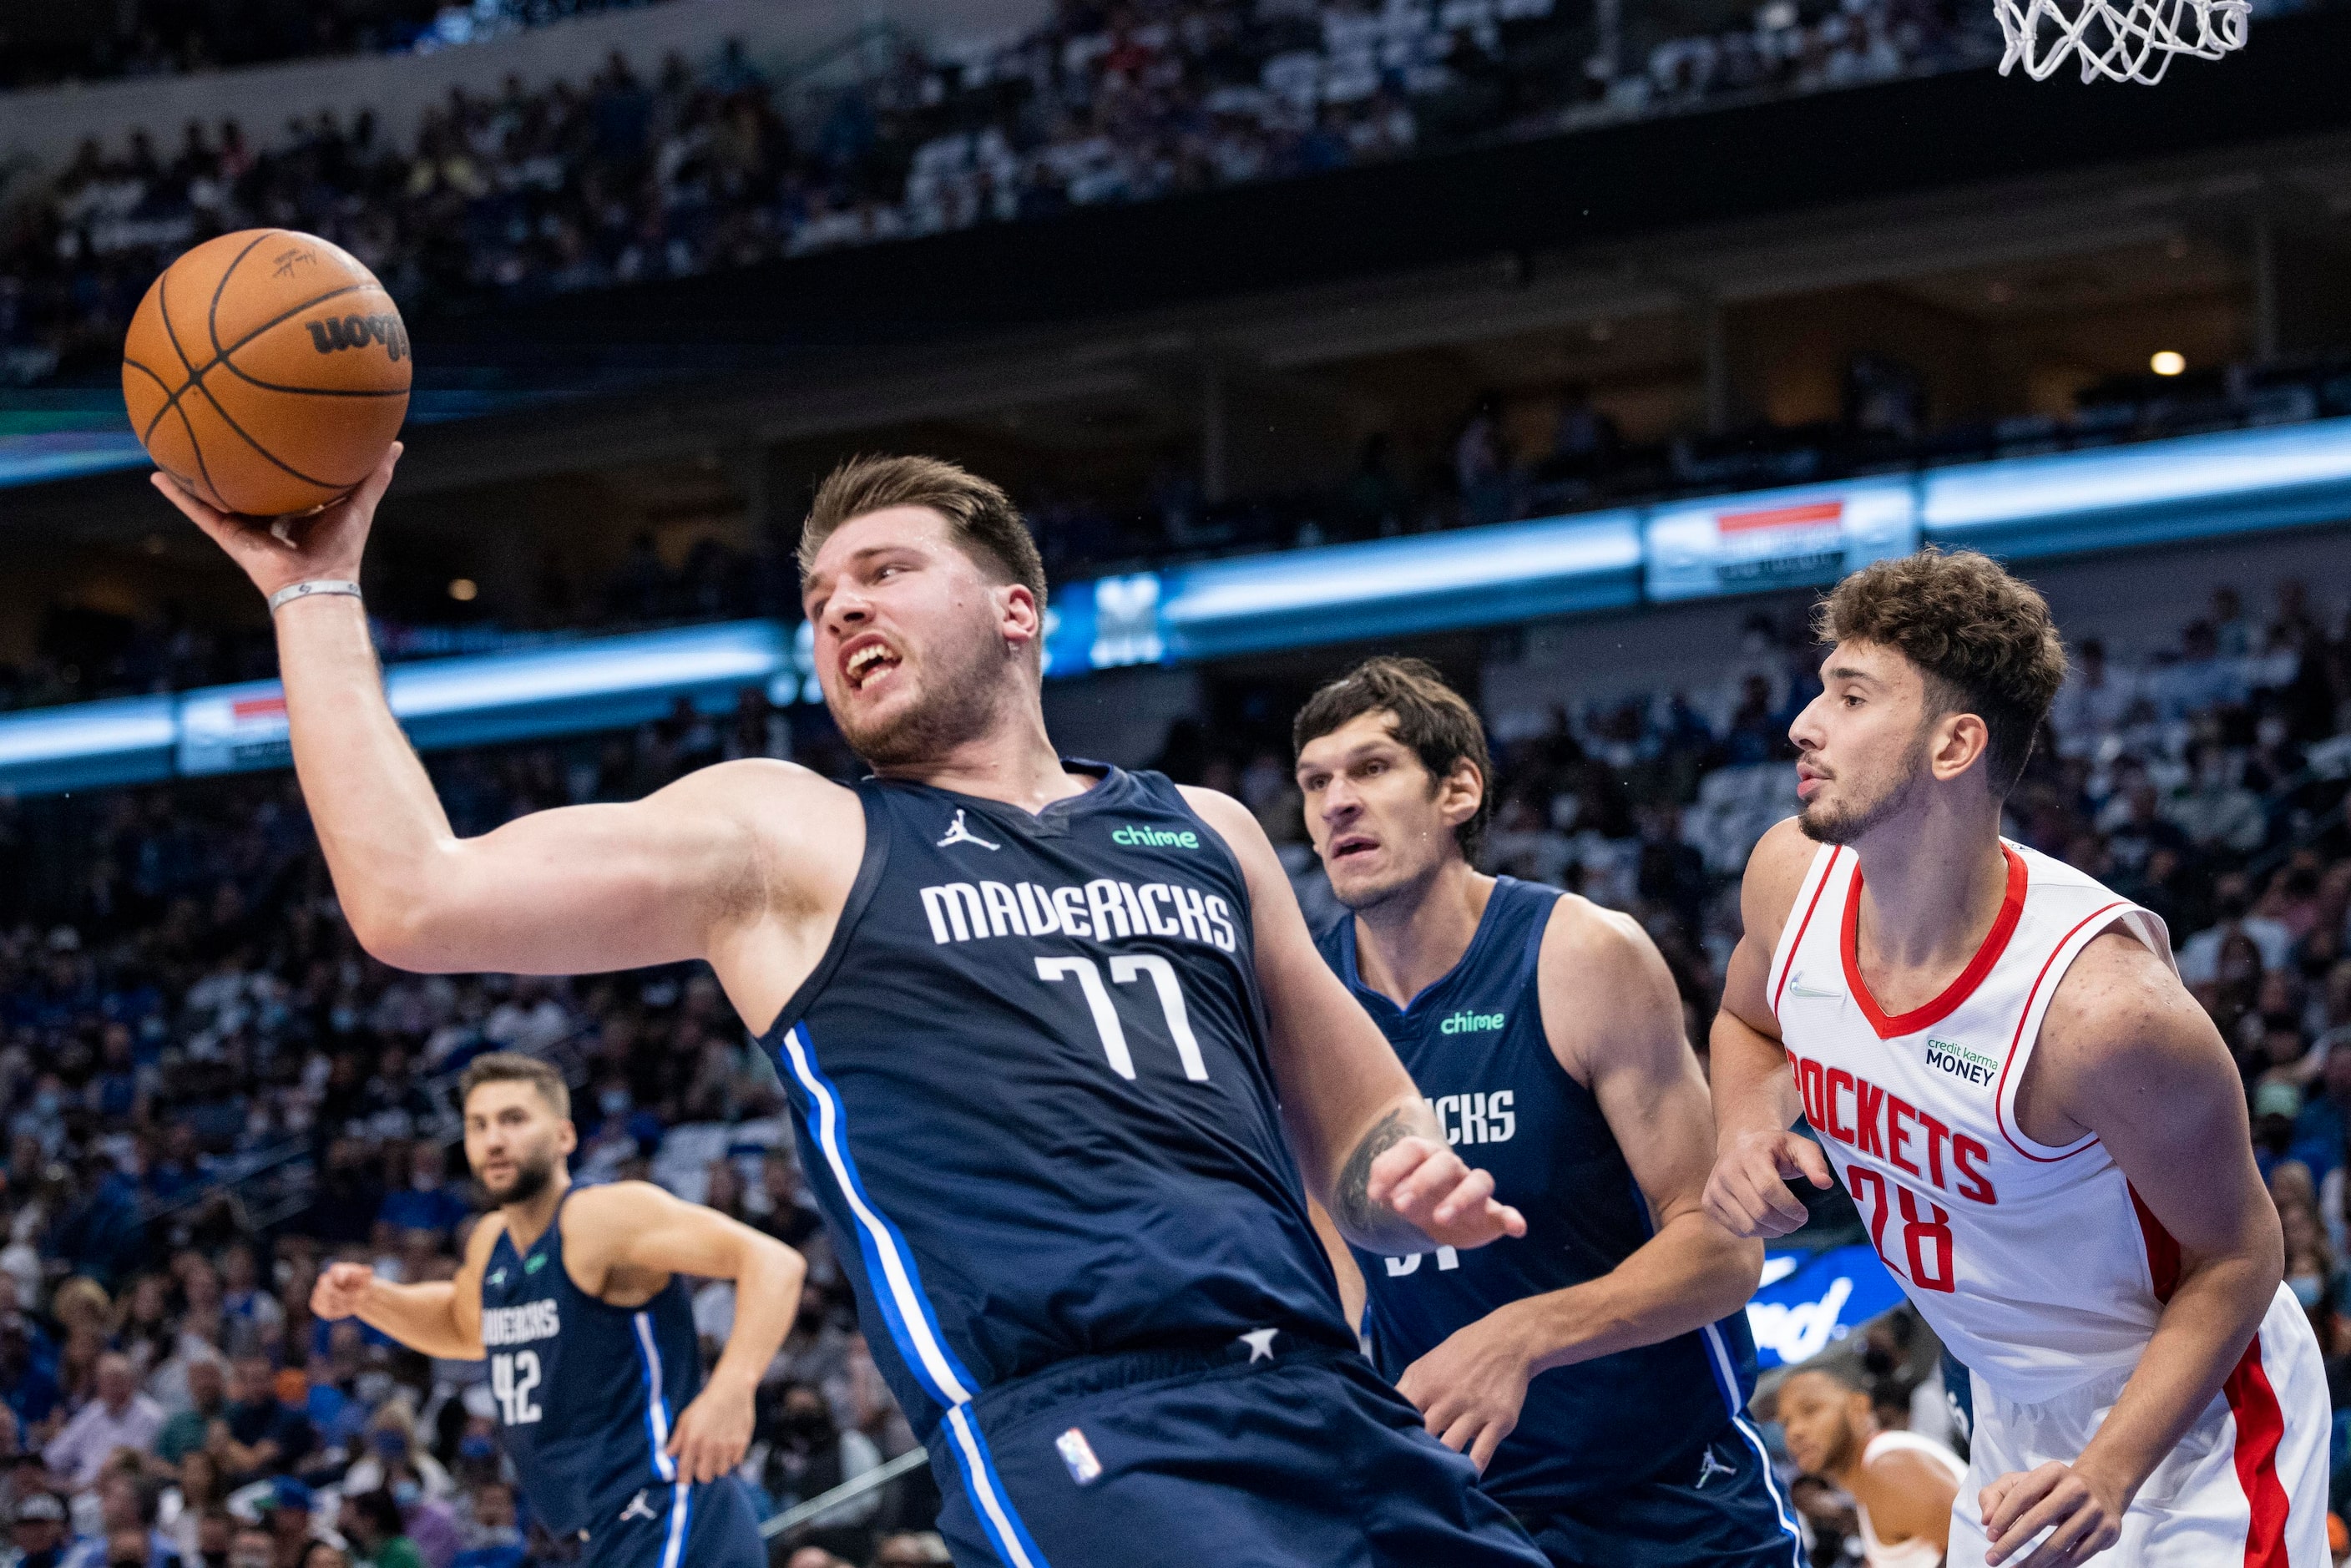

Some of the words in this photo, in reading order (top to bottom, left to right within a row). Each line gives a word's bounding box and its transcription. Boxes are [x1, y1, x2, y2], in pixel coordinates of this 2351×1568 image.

[306, 312, 412, 362] ilson
[1112, 825, 1200, 850] chime
[920, 878, 1236, 953] MAVERICKS
[1034, 954, 1209, 1081] 77
[1440, 1010, 1505, 1035] chime
[1926, 1049, 1995, 1087] MONEY
[1928, 1039, 1961, 1056] credit
[1963, 1047, 1998, 1070] karma
[1847, 1165, 1955, 1292] 28
[491, 1349, 544, 1427] 42
